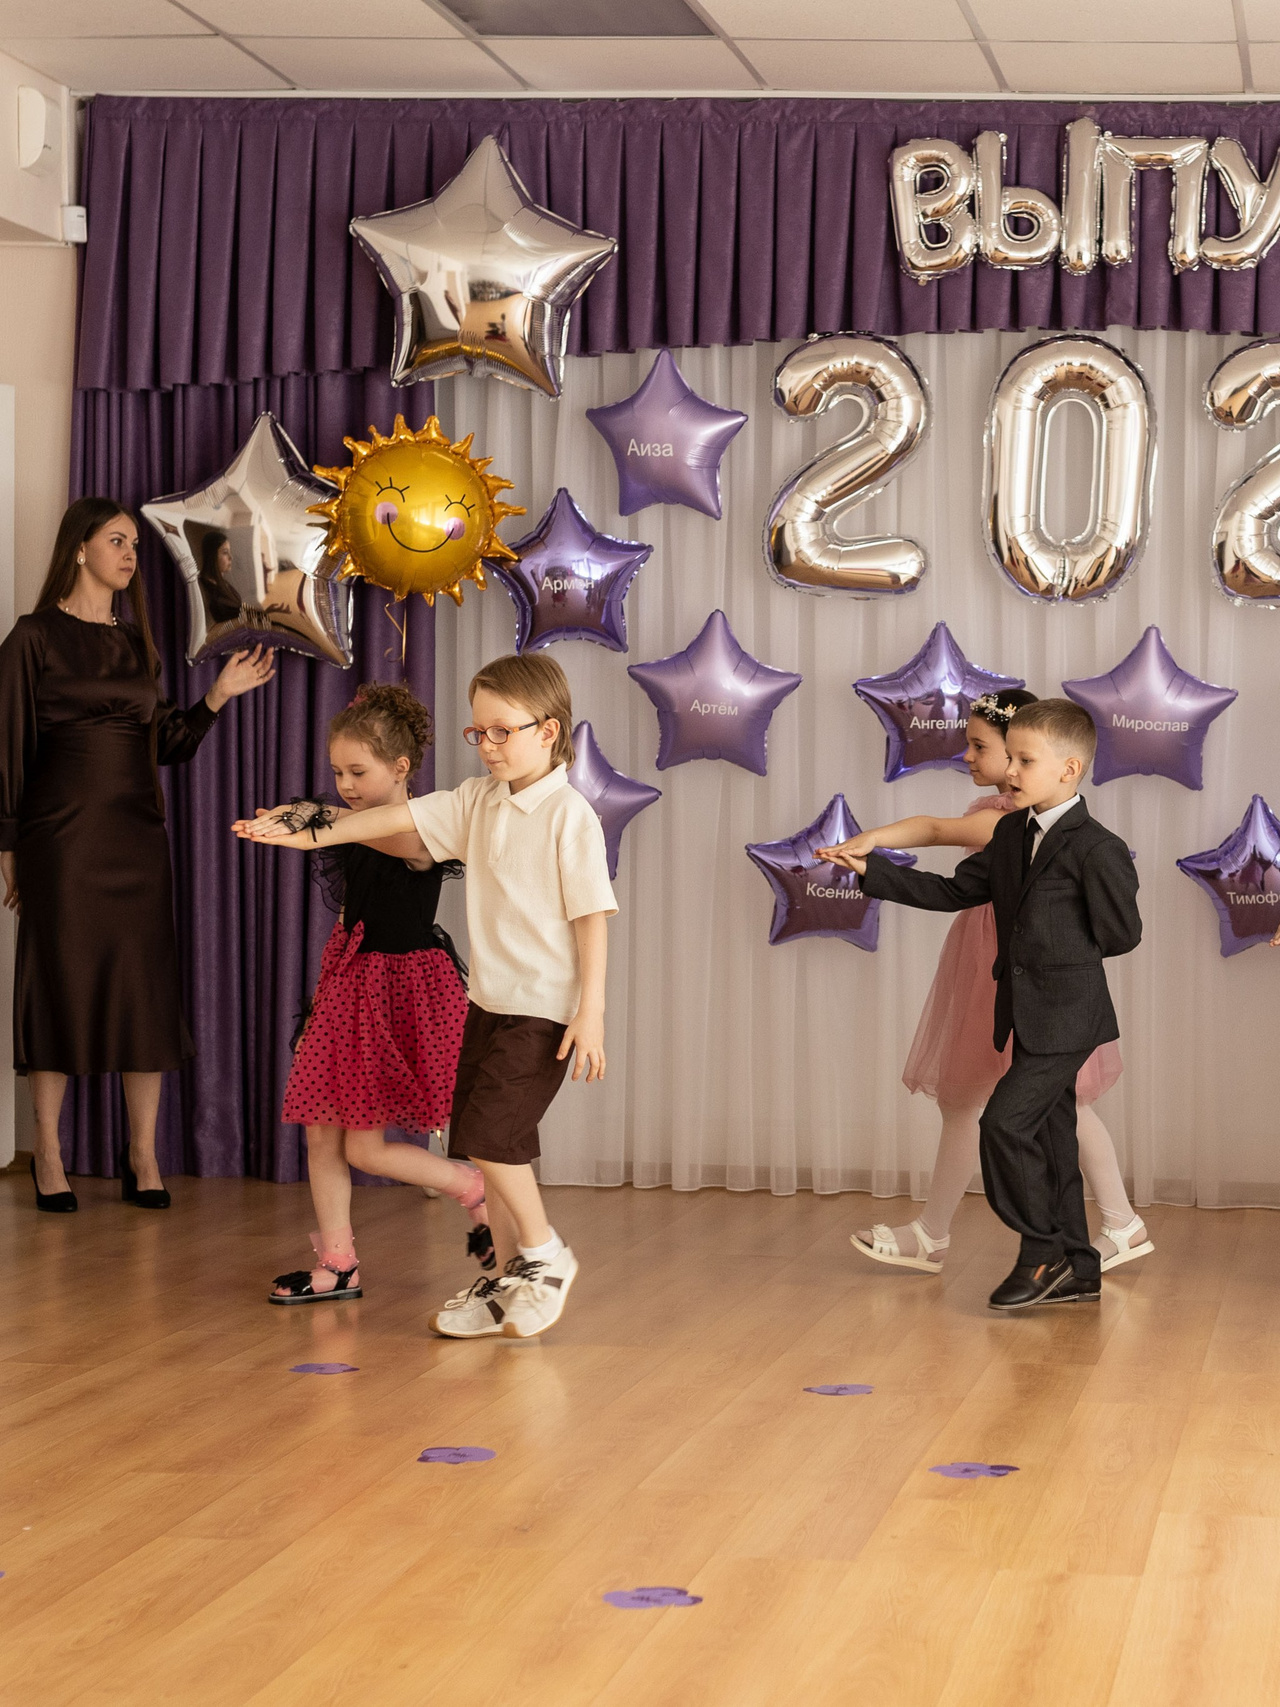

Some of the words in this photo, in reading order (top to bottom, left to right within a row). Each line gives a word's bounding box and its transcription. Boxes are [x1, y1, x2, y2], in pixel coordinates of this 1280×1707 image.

[626, 438, 674, 457] Аиза
[689, 699, 739, 716] Артём
[909, 716, 969, 730] Ангелин
[1112, 713, 1190, 732] Мирослав
[805, 882, 864, 900] Ксения
